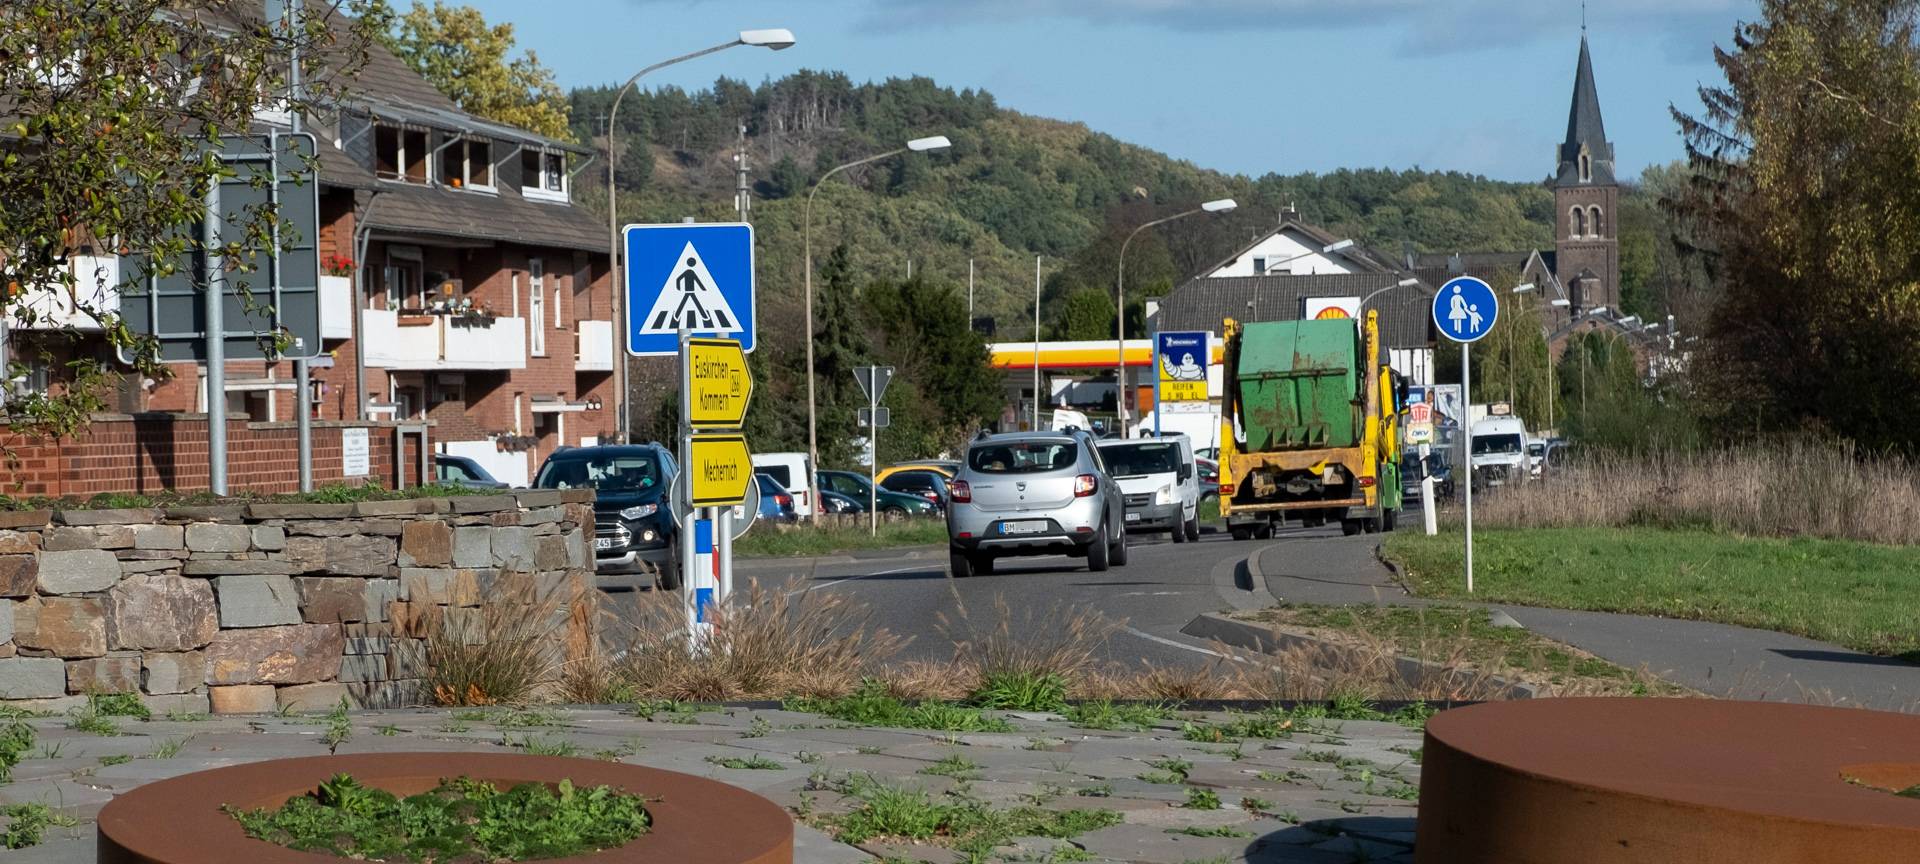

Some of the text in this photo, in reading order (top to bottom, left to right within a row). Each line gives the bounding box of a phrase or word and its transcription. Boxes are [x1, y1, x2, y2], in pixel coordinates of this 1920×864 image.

[695, 354, 729, 379] Euskirchen
[731, 374, 740, 392] 266
[700, 386, 729, 411] Kommern
[704, 457, 738, 481] Mechernich
